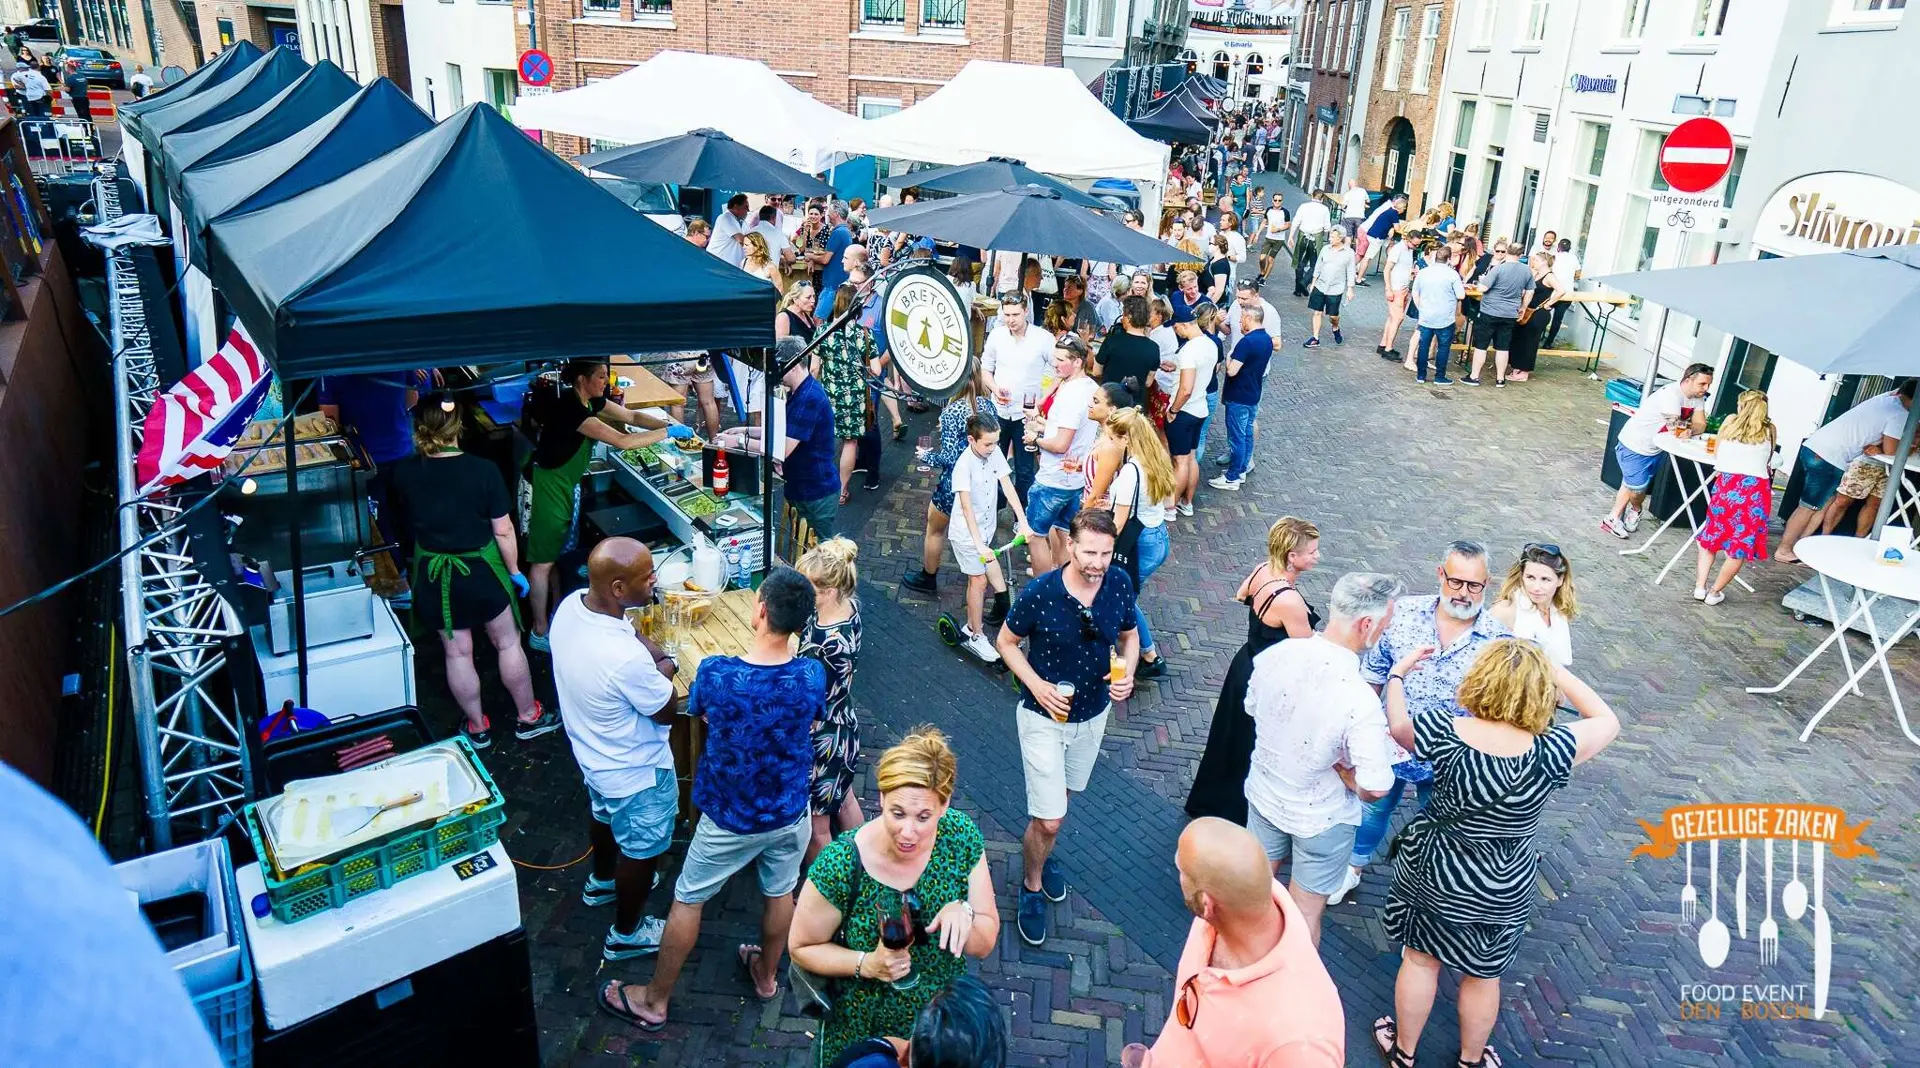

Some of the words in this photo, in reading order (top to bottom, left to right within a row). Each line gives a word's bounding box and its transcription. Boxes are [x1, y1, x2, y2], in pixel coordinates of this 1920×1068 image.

[1653, 193, 1720, 208] uitgezonderd
[900, 288, 955, 329] BRETON
[899, 340, 916, 364] SUR
[918, 360, 949, 375] PLACE
